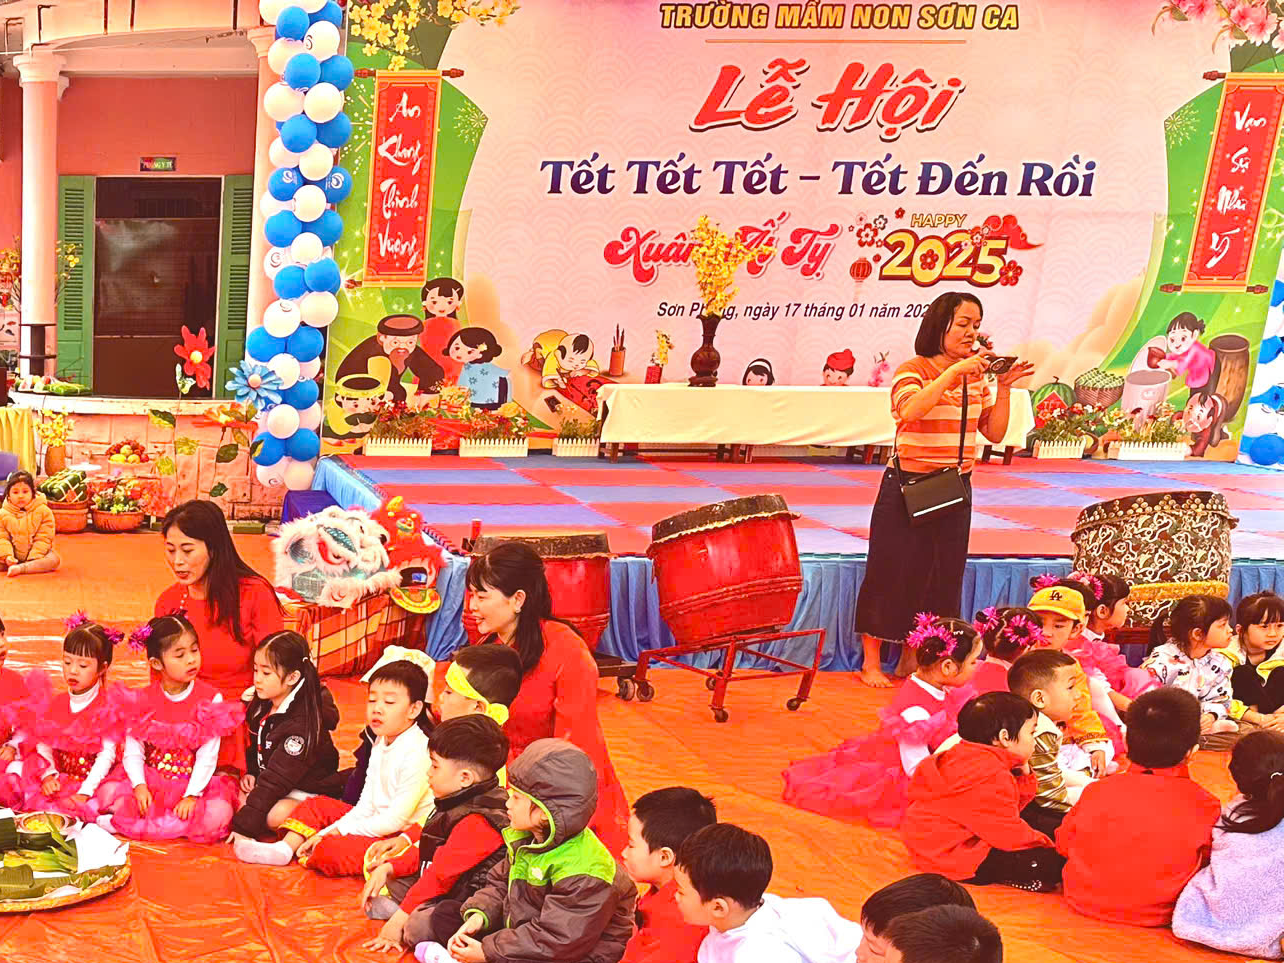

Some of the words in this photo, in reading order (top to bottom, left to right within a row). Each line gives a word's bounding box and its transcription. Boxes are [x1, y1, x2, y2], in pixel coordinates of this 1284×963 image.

[660, 0, 769, 30] TRƯỜNG
[775, 0, 844, 30] MẦM
[851, 3, 911, 30] NON
[916, 2, 977, 30] SƠN
[981, 4, 1020, 30] CA
[388, 91, 422, 123] An
[690, 57, 809, 131] Lễ
[814, 61, 964, 140] Hội
[1233, 101, 1267, 133] Vạn
[540, 152, 616, 196] Tết
[627, 152, 703, 196] Tết
[713, 152, 788, 196] Tết
[832, 152, 907, 196] Tết
[916, 152, 1009, 196] Đến
[1017, 154, 1098, 198] Rồi
[1230, 145, 1252, 174] Sự
[379, 178, 420, 220] Thịnh
[910, 213, 968, 228] HAPPY
[780, 223, 841, 278] Tỵ
[879, 228, 1010, 288] 2025
[1205, 227, 1241, 269] Ý
[657, 301, 685, 317] Sơn
[744, 301, 779, 321] ngày
[784, 303, 801, 317] 17
[804, 301, 845, 321] tháng
[848, 303, 866, 317] 01
[869, 303, 901, 318] năm
